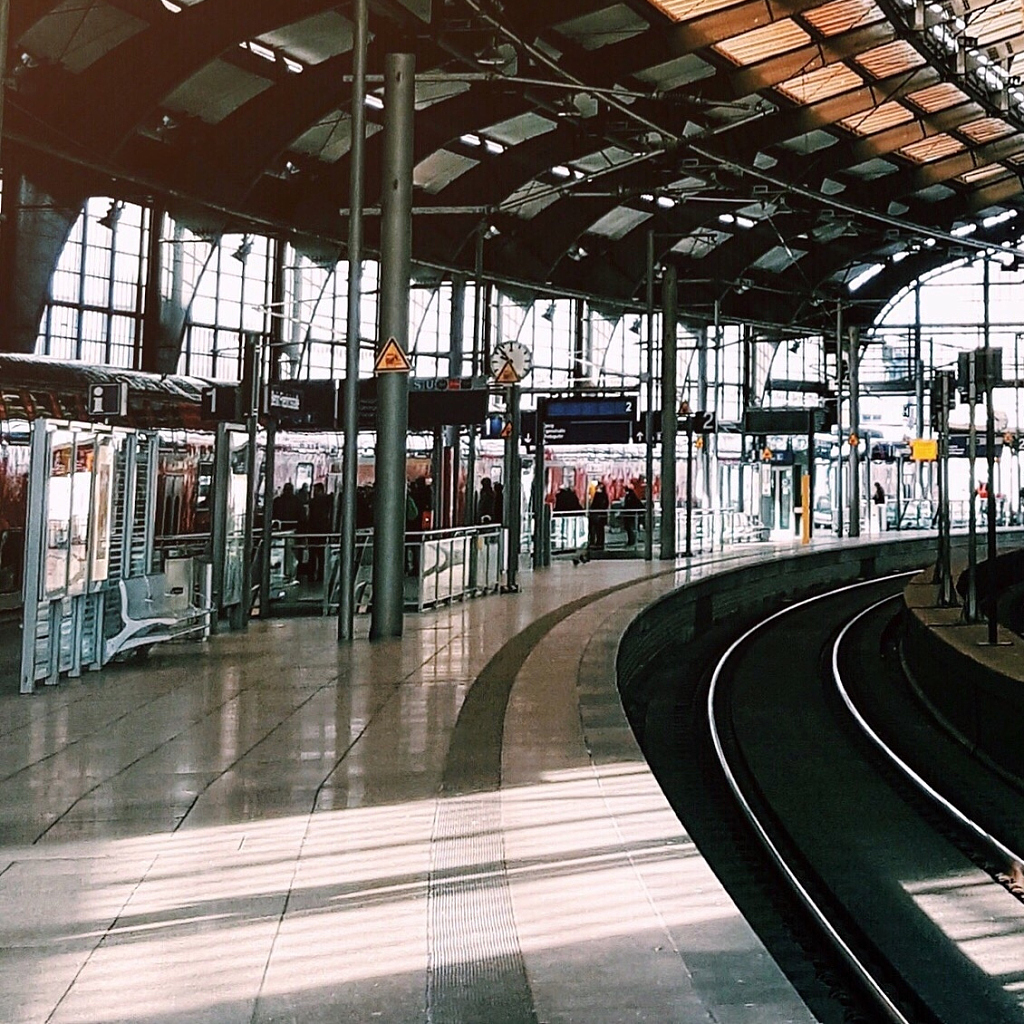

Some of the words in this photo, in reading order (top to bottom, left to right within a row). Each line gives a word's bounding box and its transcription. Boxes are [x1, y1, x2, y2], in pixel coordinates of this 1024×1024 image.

[413, 380, 422, 389] S
[425, 381, 433, 389] U
[206, 388, 217, 413] 1
[625, 402, 632, 412] 2
[703, 412, 714, 429] 2
